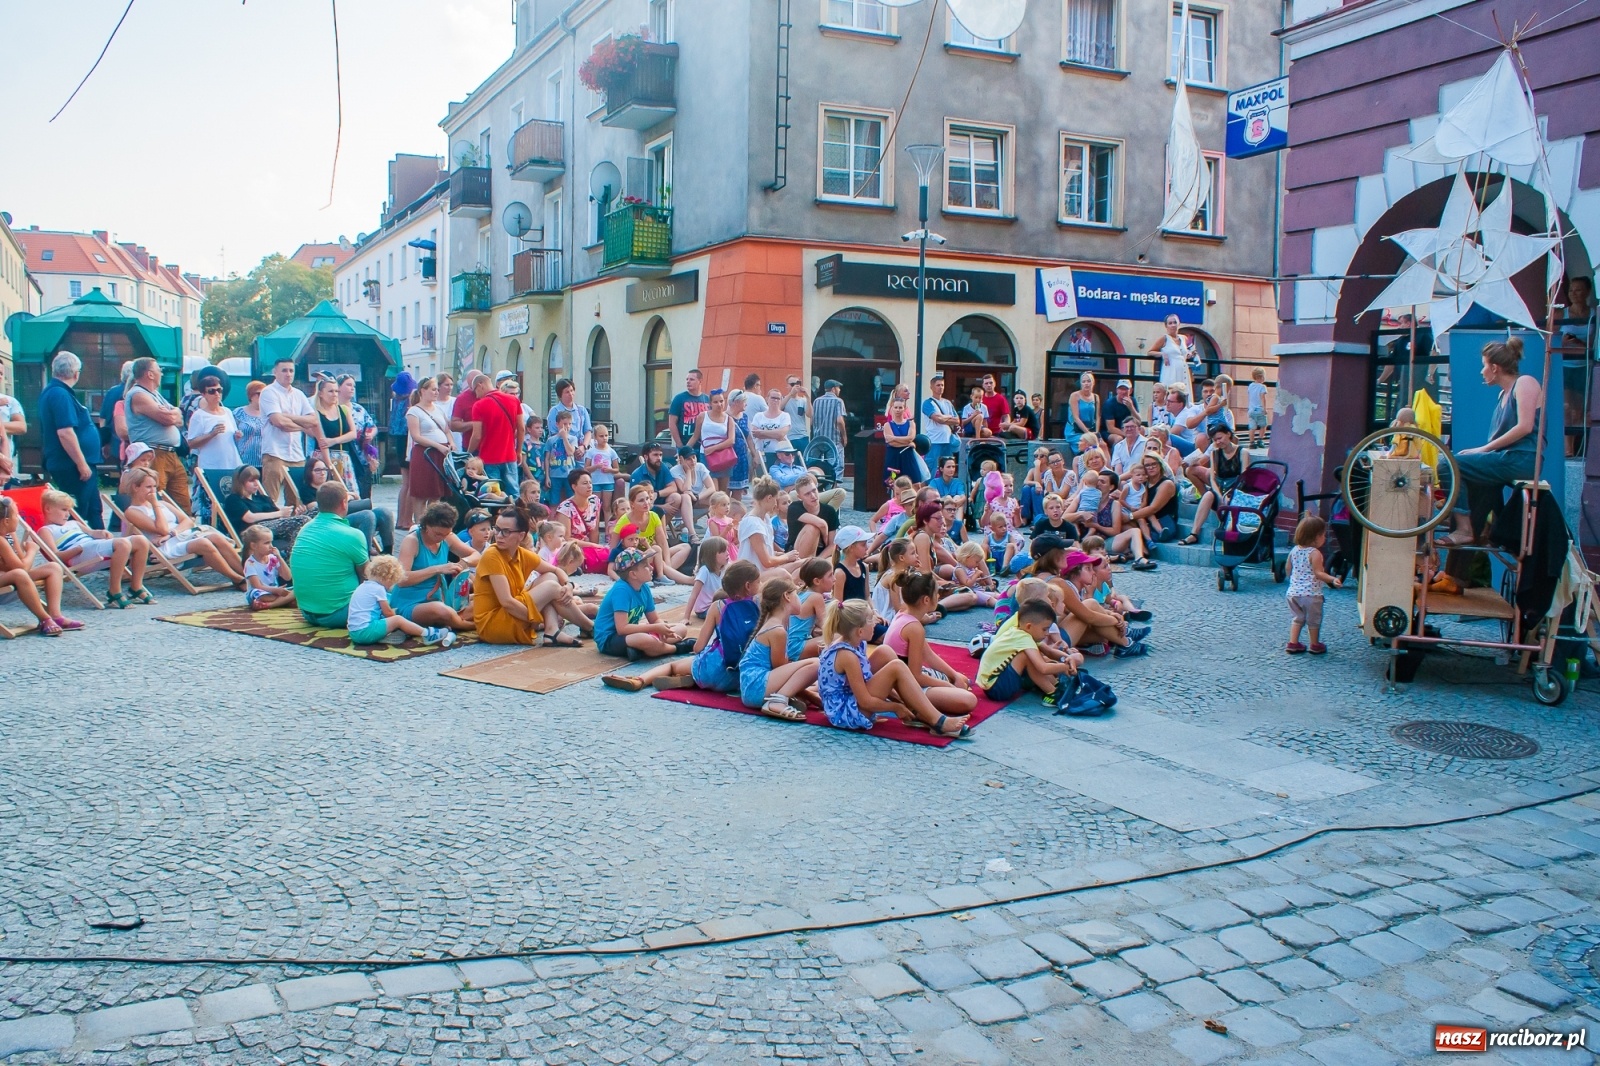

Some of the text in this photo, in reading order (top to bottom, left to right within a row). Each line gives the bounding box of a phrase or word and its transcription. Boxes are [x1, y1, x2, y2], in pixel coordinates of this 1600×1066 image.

[1235, 86, 1285, 112] MAXPOL
[1077, 286, 1121, 300] Bodara
[1129, 291, 1168, 305] męska
[1170, 295, 1200, 306] rzecz
